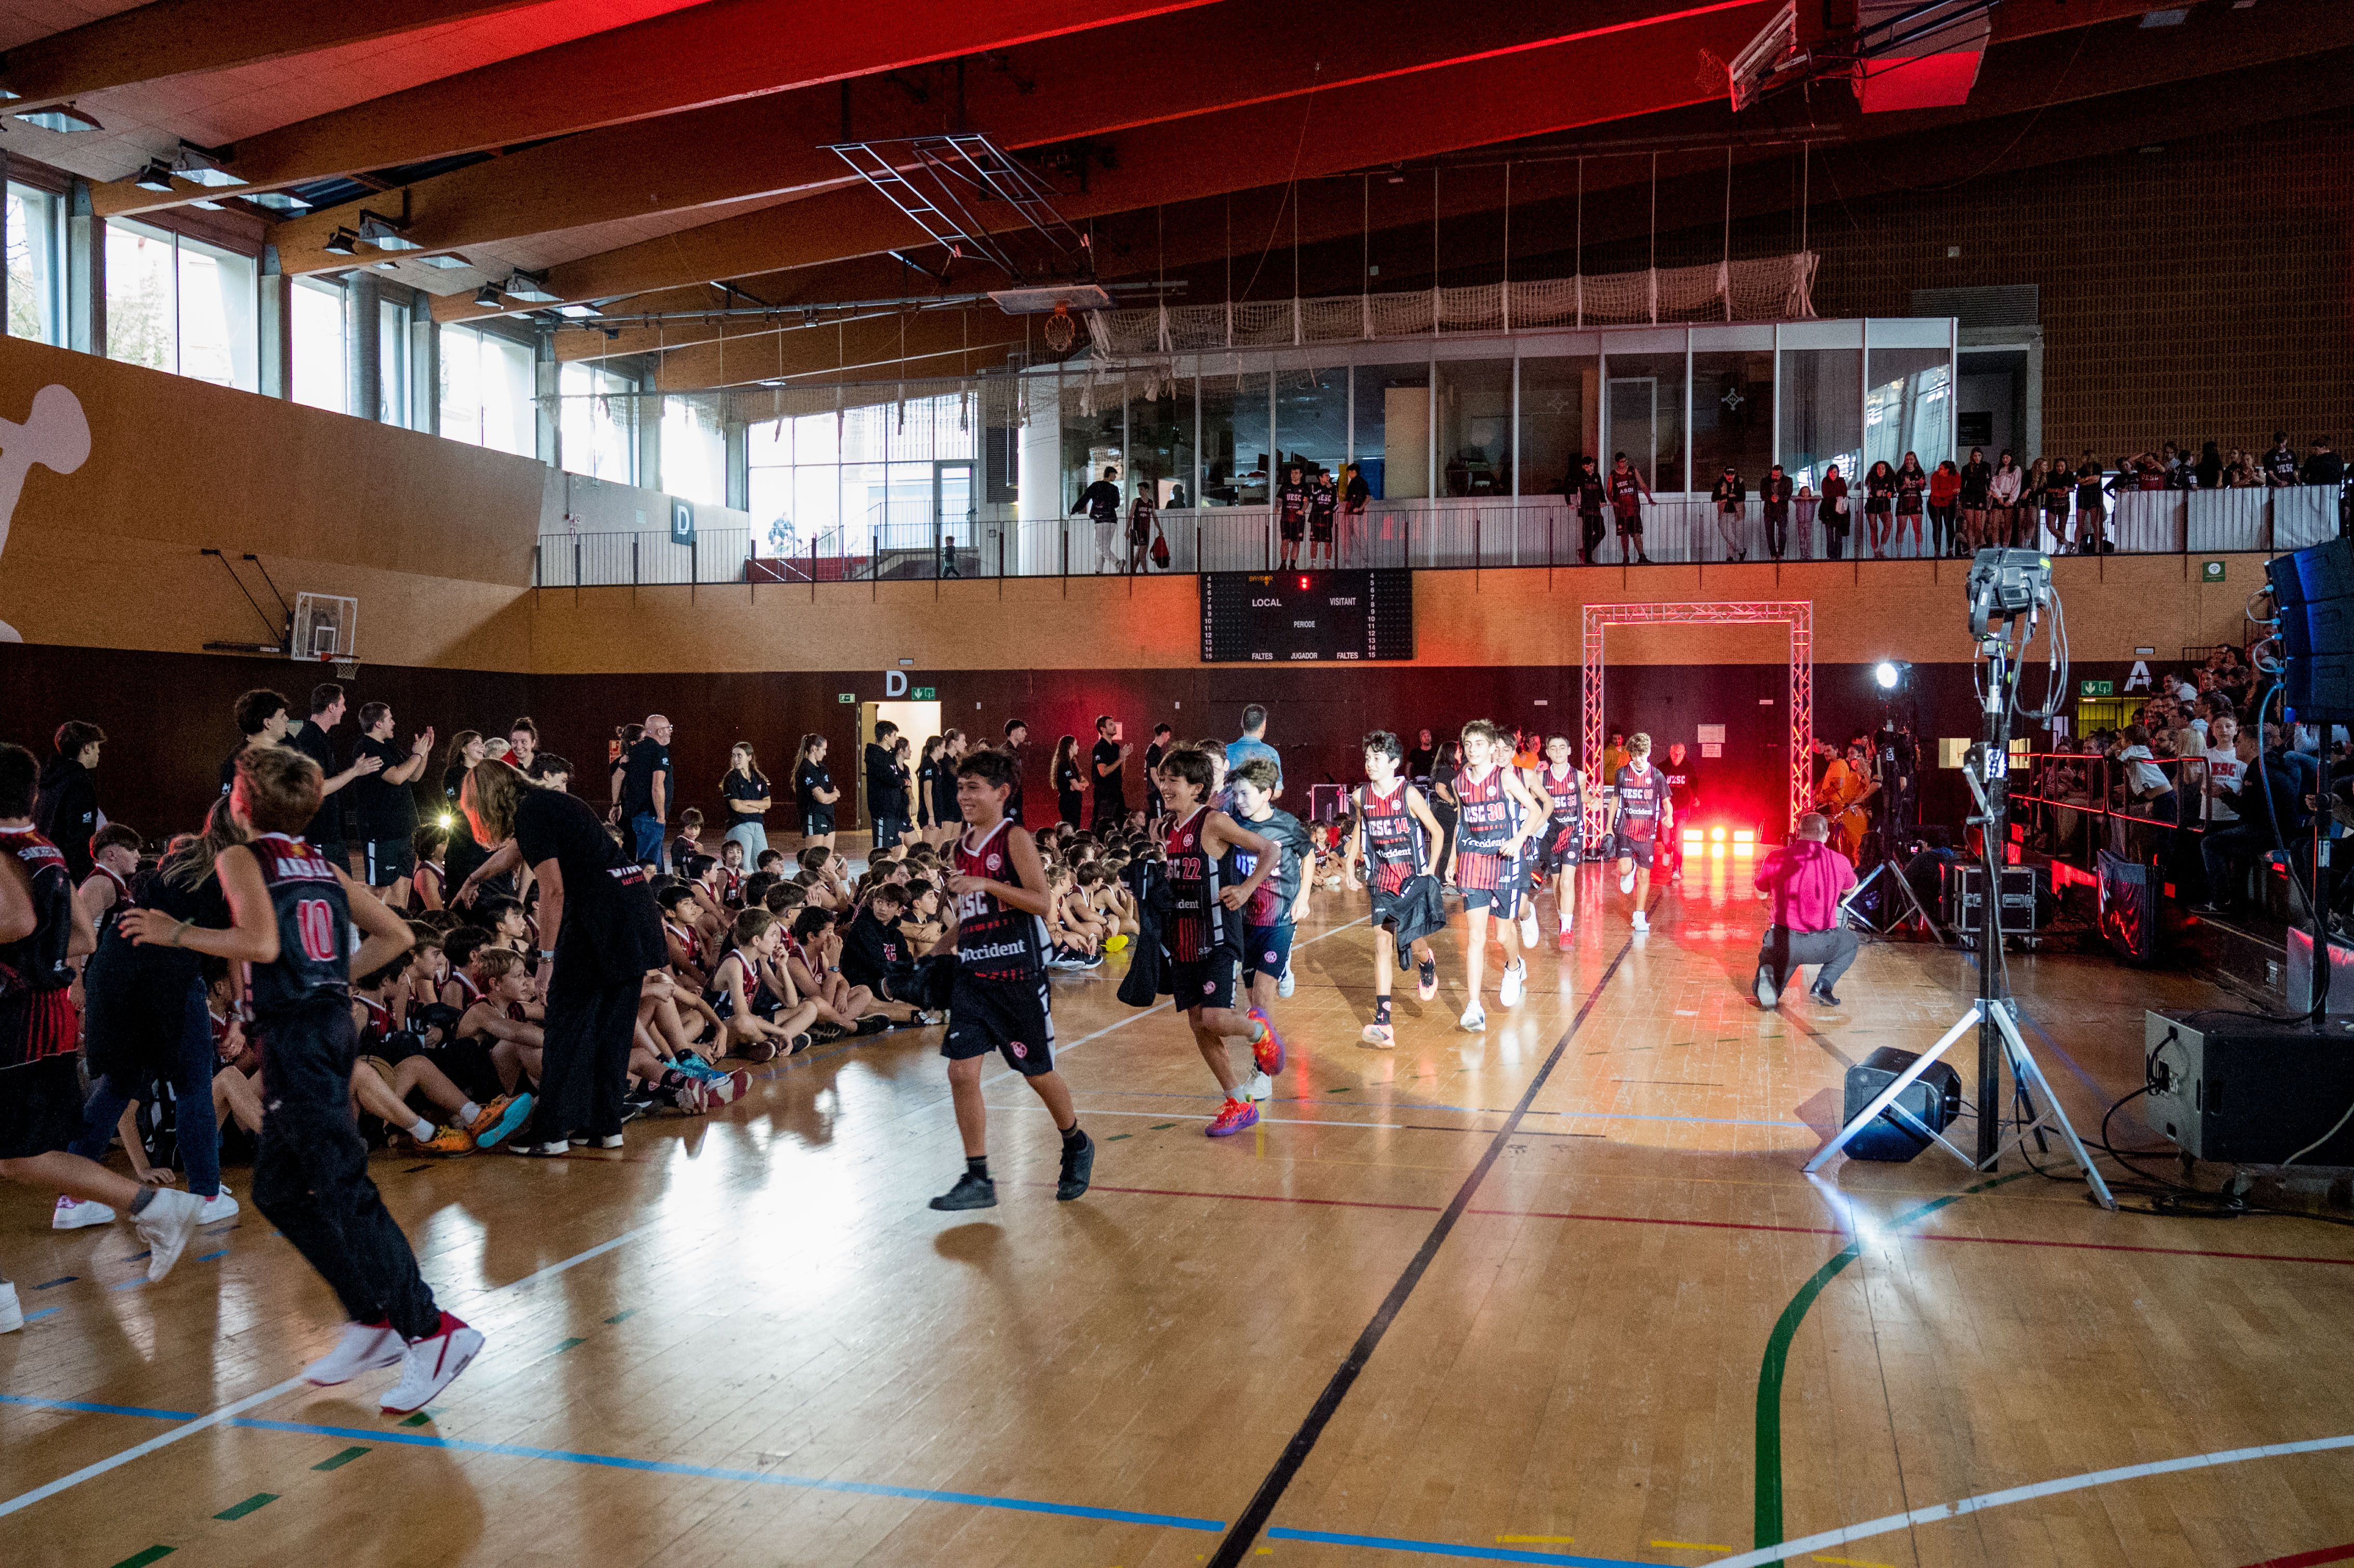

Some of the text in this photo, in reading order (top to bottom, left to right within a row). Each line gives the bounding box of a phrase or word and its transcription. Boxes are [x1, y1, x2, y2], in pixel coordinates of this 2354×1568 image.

[2277, 464, 2293, 473] UESC
[677, 504, 689, 535] D
[1252, 598, 1281, 607] LOCAL
[1329, 597, 1356, 606] VISITANT
[886, 670, 907, 697] D
[2123, 661, 2152, 691] A
[2212, 762, 2237, 777] ESC
[1623, 788, 1643, 799] UESC
[1487, 802, 1506, 821] 30
[1394, 817, 1411, 834] 14
[1182, 858, 1201, 880] 22
[297, 899, 338, 961] 10
